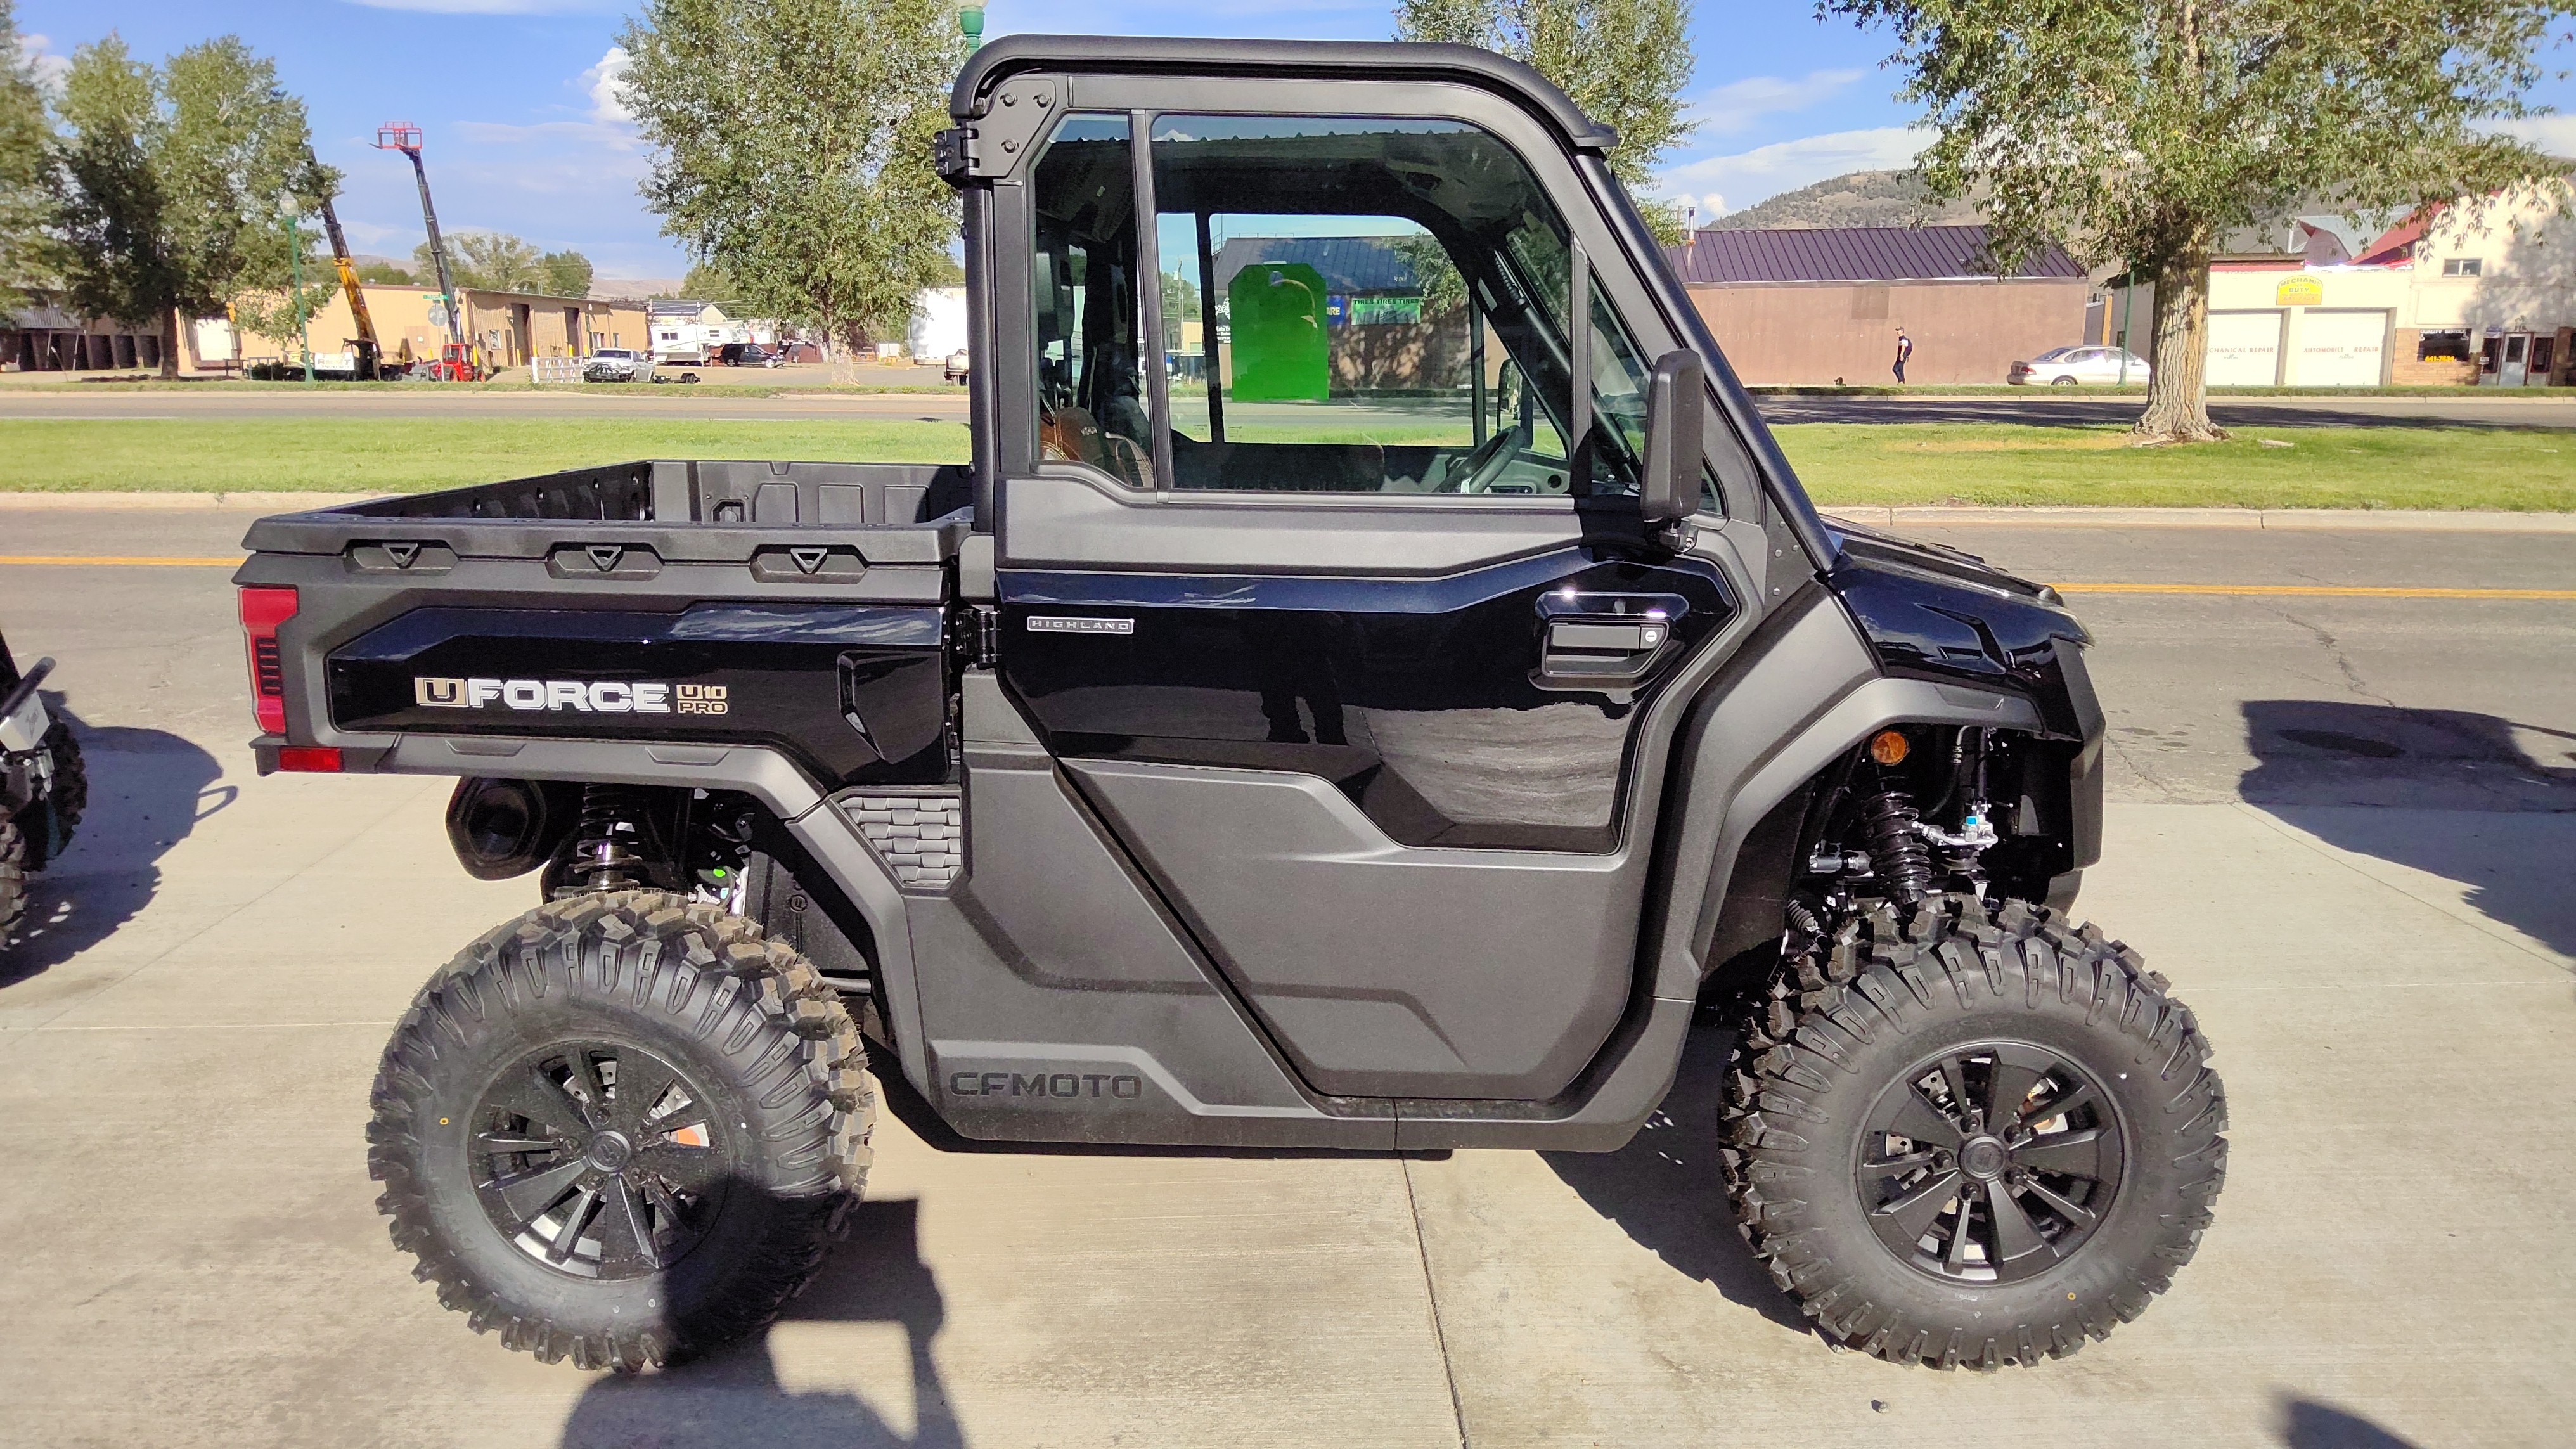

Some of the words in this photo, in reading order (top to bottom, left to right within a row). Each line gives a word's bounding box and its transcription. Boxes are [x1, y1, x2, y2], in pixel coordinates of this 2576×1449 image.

[2280, 278, 2321, 287] MECHANIC
[1031, 619, 1130, 631] HIGHLAND
[676, 685, 727, 700] U10
[677, 700, 728, 714] PRO
[950, 1071, 1142, 1099] CFMOTO
